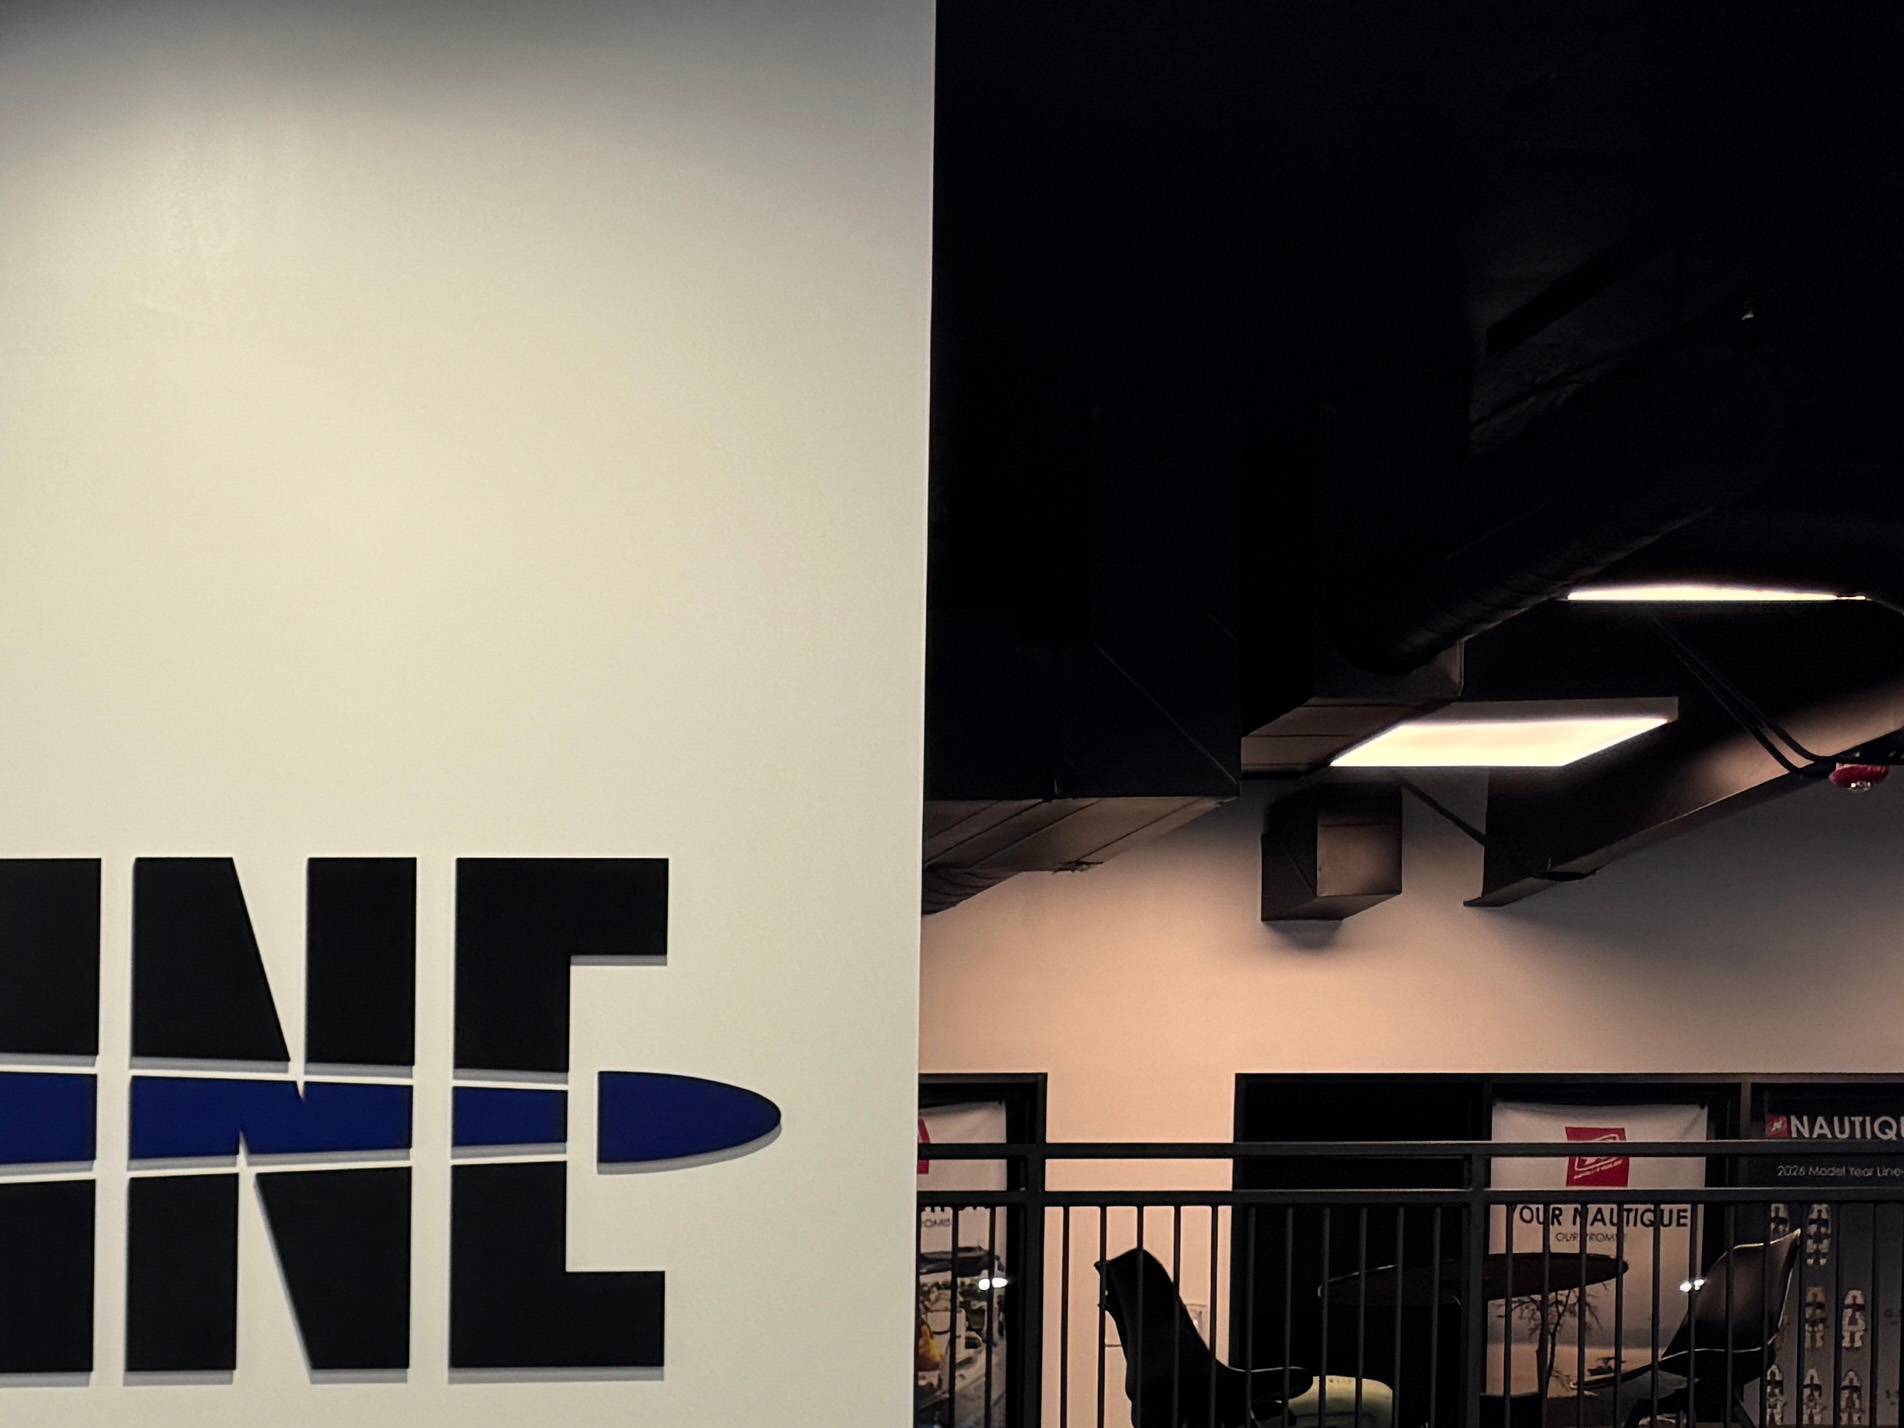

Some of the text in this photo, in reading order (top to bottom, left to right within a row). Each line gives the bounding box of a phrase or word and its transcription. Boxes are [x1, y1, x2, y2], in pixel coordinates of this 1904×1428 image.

[1791, 1115, 1904, 1140] NAUTIQ
[1808, 1165, 1846, 1177] Model
[1849, 1166, 1874, 1177] Year
